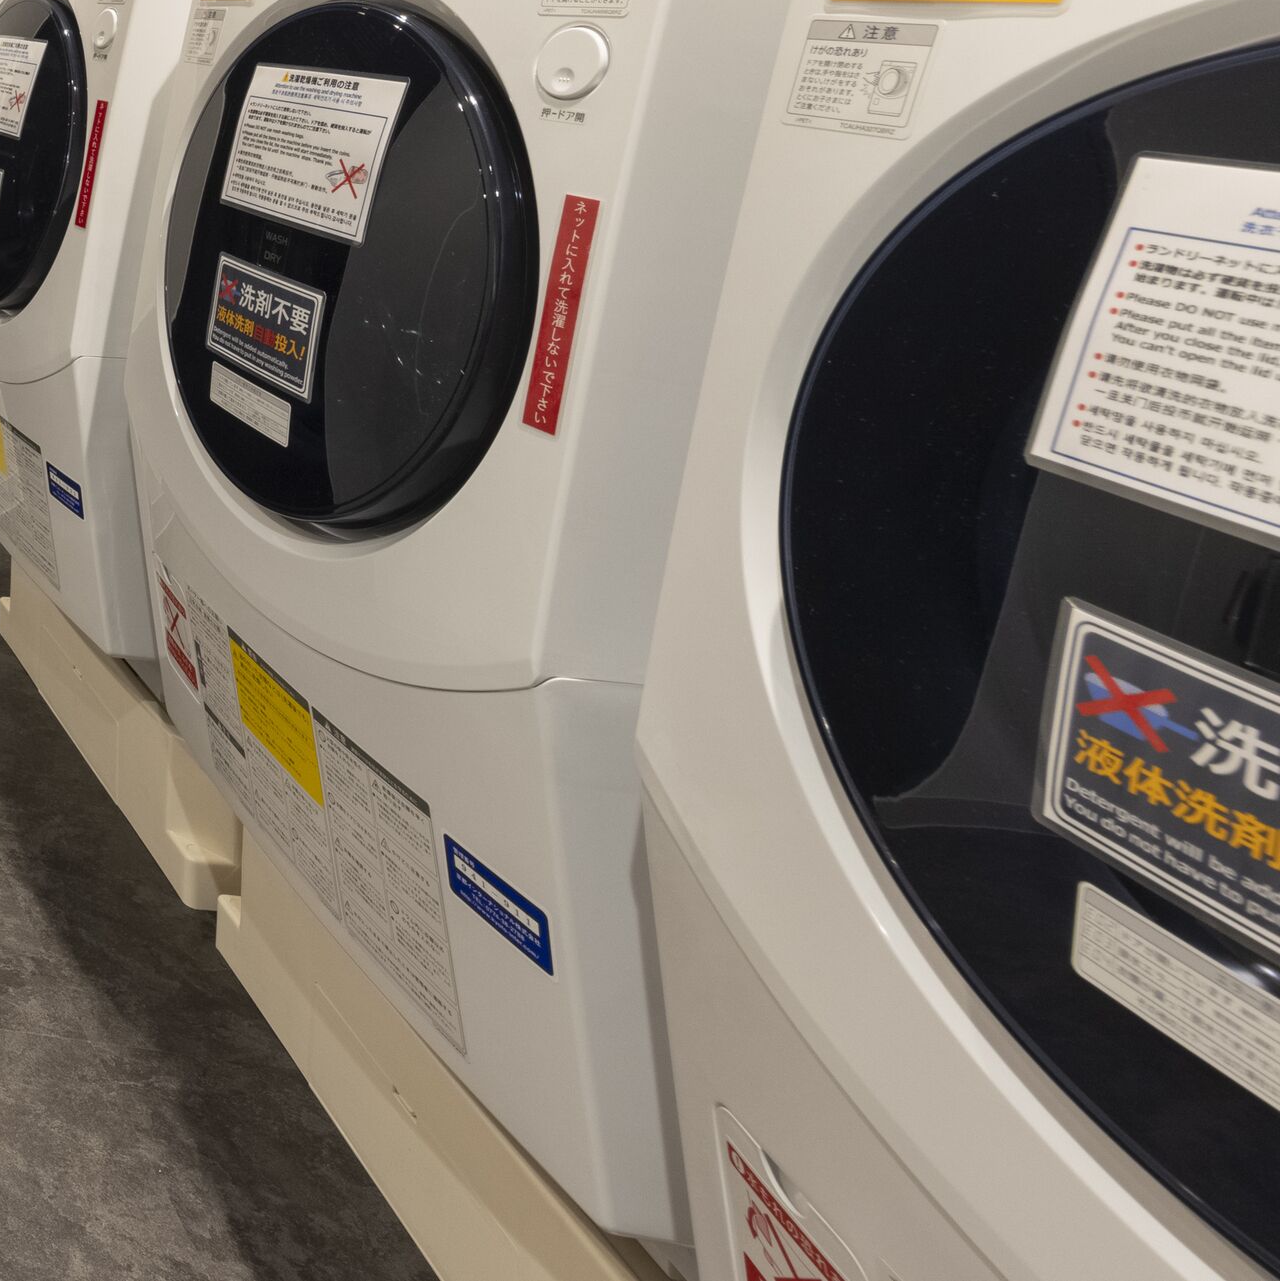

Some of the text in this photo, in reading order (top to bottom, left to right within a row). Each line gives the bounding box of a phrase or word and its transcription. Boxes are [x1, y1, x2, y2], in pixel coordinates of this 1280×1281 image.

[810, 45, 868, 58] けがの恐れあり
[862, 25, 899, 40] 注意
[264, 251, 282, 265] DRY
[265, 230, 289, 247] WASH
[238, 281, 311, 336] 洗剤不要
[534, 201, 587, 424] ネットに入れて洗濯しないで下さい
[1191, 708, 1280, 802] 洗
[1066, 776, 1236, 881] Detergent will be
[1074, 729, 1280, 871] 液体洗剤
[1064, 793, 1245, 903] You do not have to
